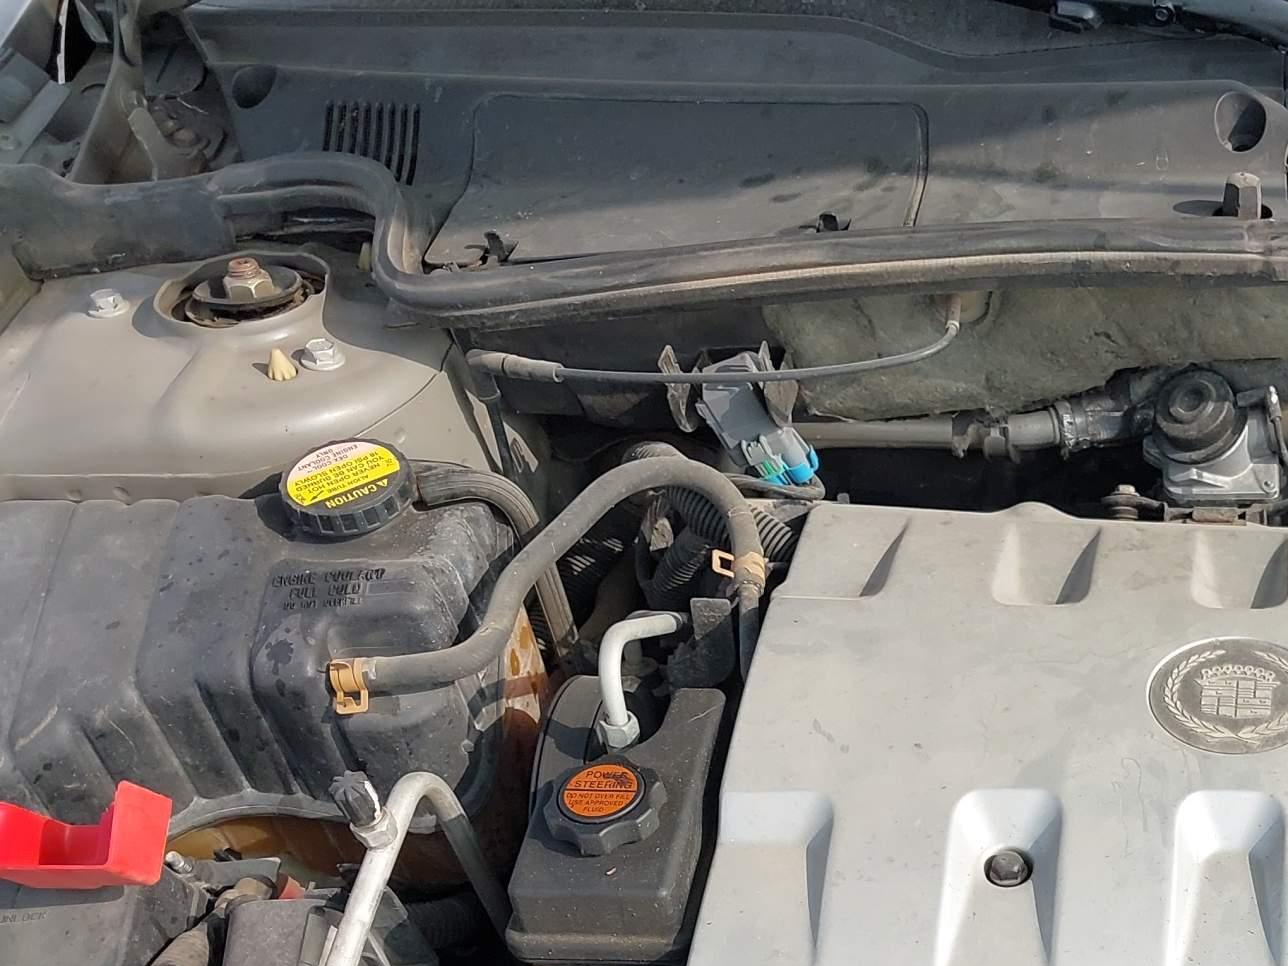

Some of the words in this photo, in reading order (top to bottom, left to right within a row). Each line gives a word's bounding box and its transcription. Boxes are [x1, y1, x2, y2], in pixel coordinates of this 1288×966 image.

[365, 454, 384, 465] YOU
[328, 460, 352, 473] OPEN
[346, 462, 364, 473] CAN
[293, 470, 326, 486] SLOWLY
[326, 473, 349, 486] OPEN
[306, 482, 325, 494] HOT
[324, 483, 376, 509] CAUTION
[574, 780, 632, 789] STEERING
